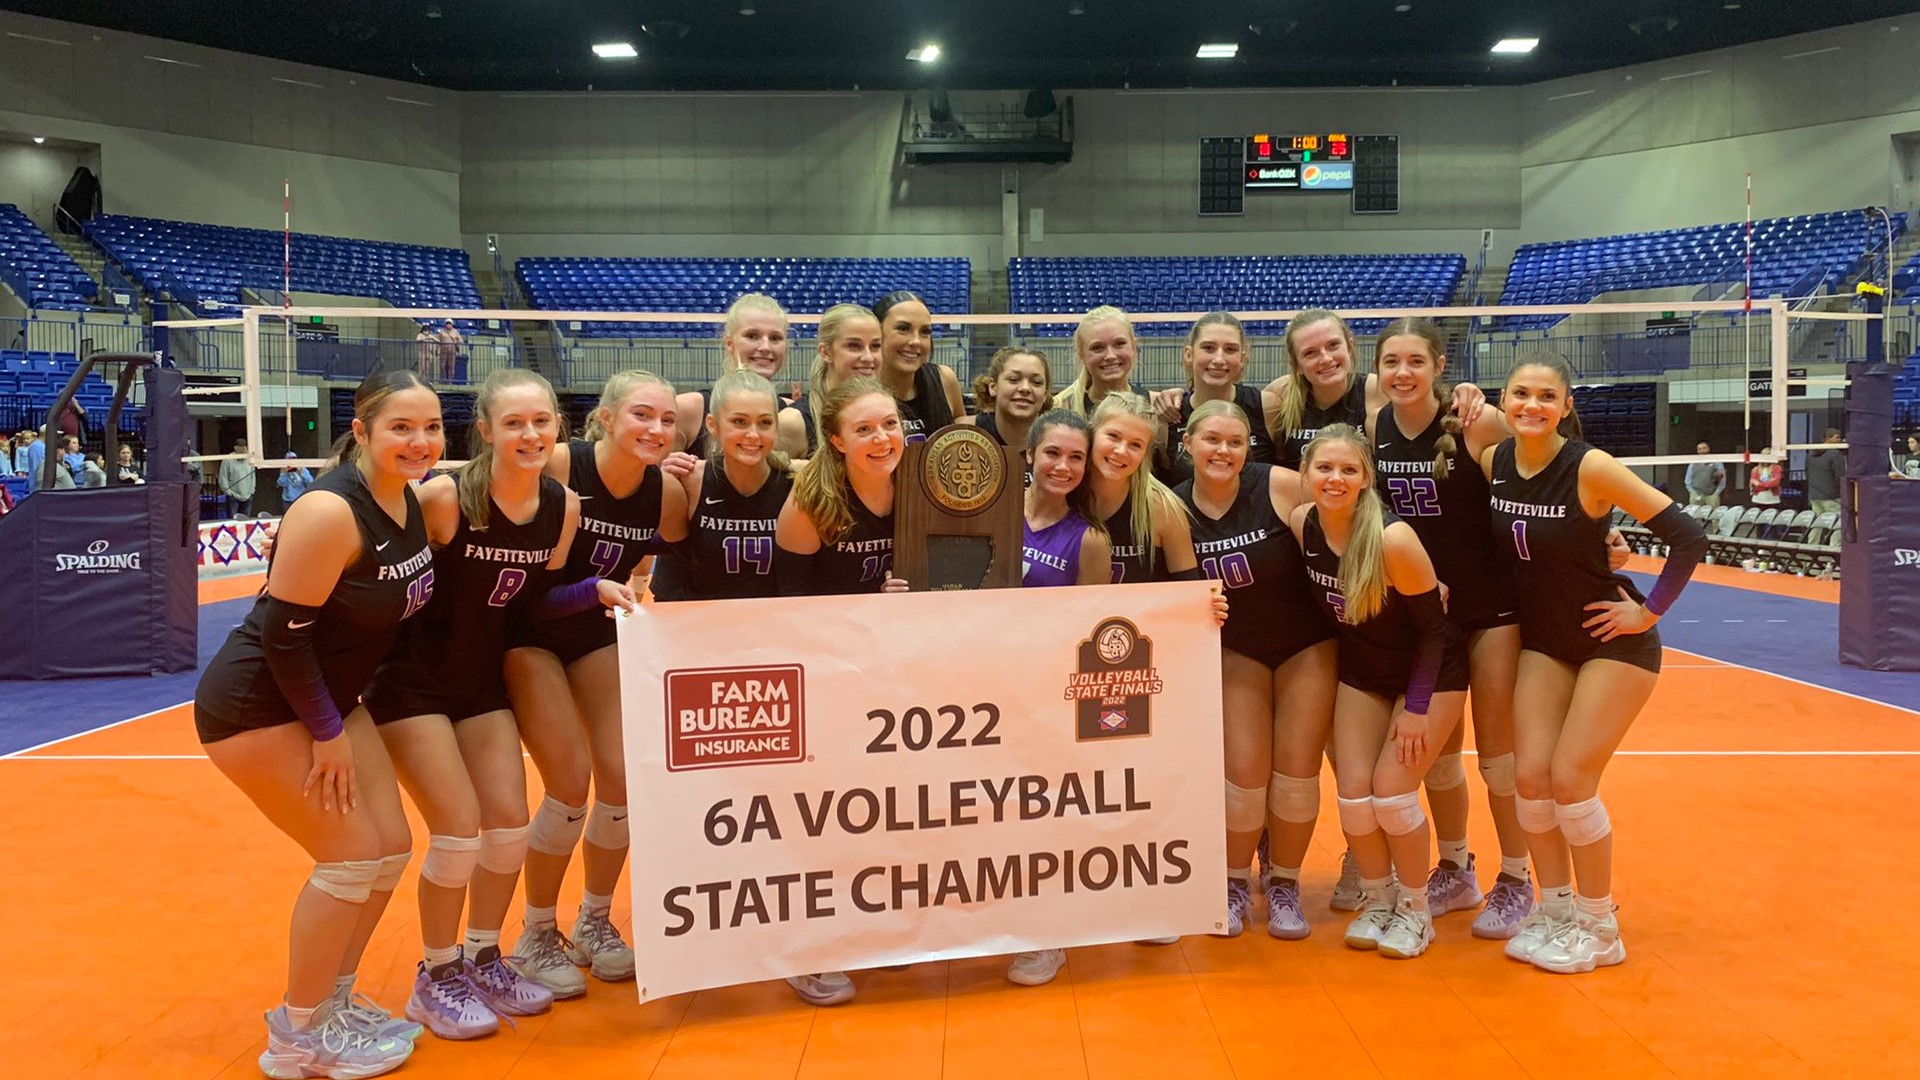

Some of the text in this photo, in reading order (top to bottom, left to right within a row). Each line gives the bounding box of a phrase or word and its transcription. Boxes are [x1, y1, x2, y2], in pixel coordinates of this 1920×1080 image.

[1292, 136, 1317, 149] 1:00
[1322, 170, 1351, 181] pepsi
[1387, 478, 1442, 516] 22
[590, 539, 625, 578] 4
[722, 536, 773, 575] 14
[1511, 520, 1531, 561] 1
[56, 552, 142, 571] SPALDING
[1202, 551, 1254, 591] 10
[400, 568, 435, 621] 15
[488, 568, 527, 607] 8
[711, 678, 790, 705] FARM
[1065, 681, 1162, 699] STATE FINALS
[1070, 669, 1159, 686] VOLLEYBALL
[679, 703, 791, 733] BUREAU
[1102, 696, 1126, 705] 2022
[694, 736, 790, 757] INSURANCE
[865, 702, 1001, 754] 2022
[703, 767, 1151, 846] 6A VOLLEYBALL
[663, 839, 1192, 937] STATE CHAMPIONS
